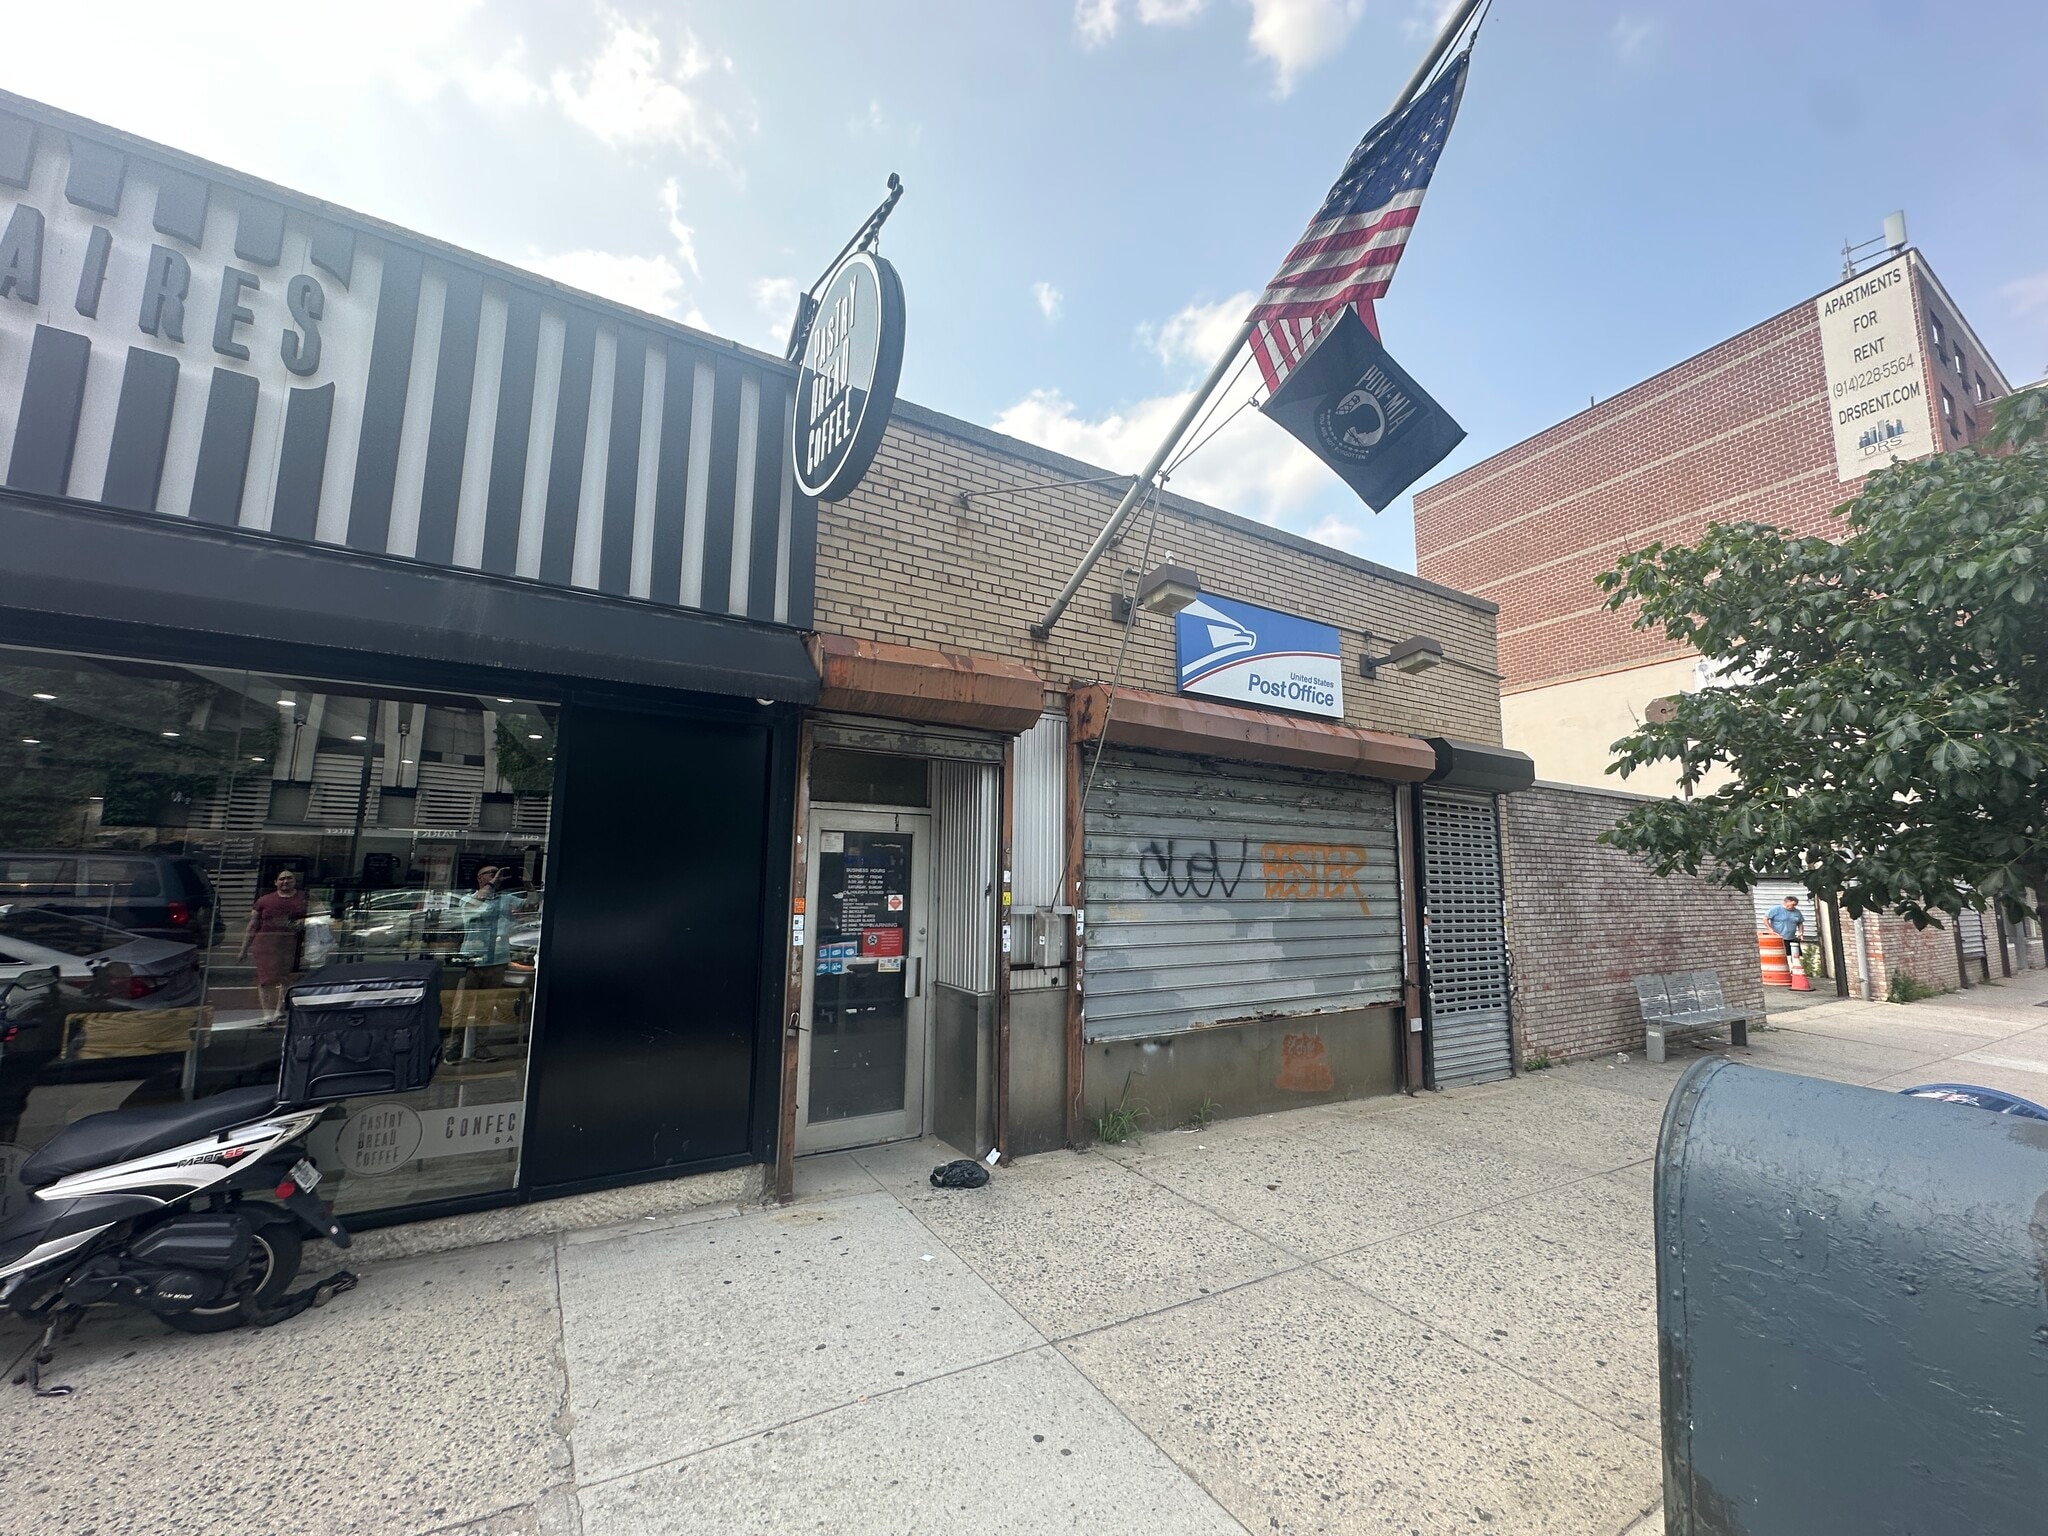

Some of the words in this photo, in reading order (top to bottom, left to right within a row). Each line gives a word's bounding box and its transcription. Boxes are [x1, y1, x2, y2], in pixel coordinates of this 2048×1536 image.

[0, 202, 326, 377] AIRES
[1824, 267, 1902, 317] APARTMENTS
[813, 274, 858, 376] PASTRY
[1853, 310, 1878, 333] FOR
[1853, 337, 1886, 363] RENT
[810, 337, 851, 427] BREAD
[1832, 353, 1915, 400] (914)228-5564
[1838, 381, 1921, 425] DRSRENT.COM
[806, 384, 853, 476] COFFEE
[1864, 435, 1903, 456] DRS
[1248, 673, 1286, 698] Post
[1287, 682, 1335, 707] Office
[1290, 671, 1313, 685] United
[1313, 676, 1335, 689] States
[445, 1112, 516, 1139] CONFEC
